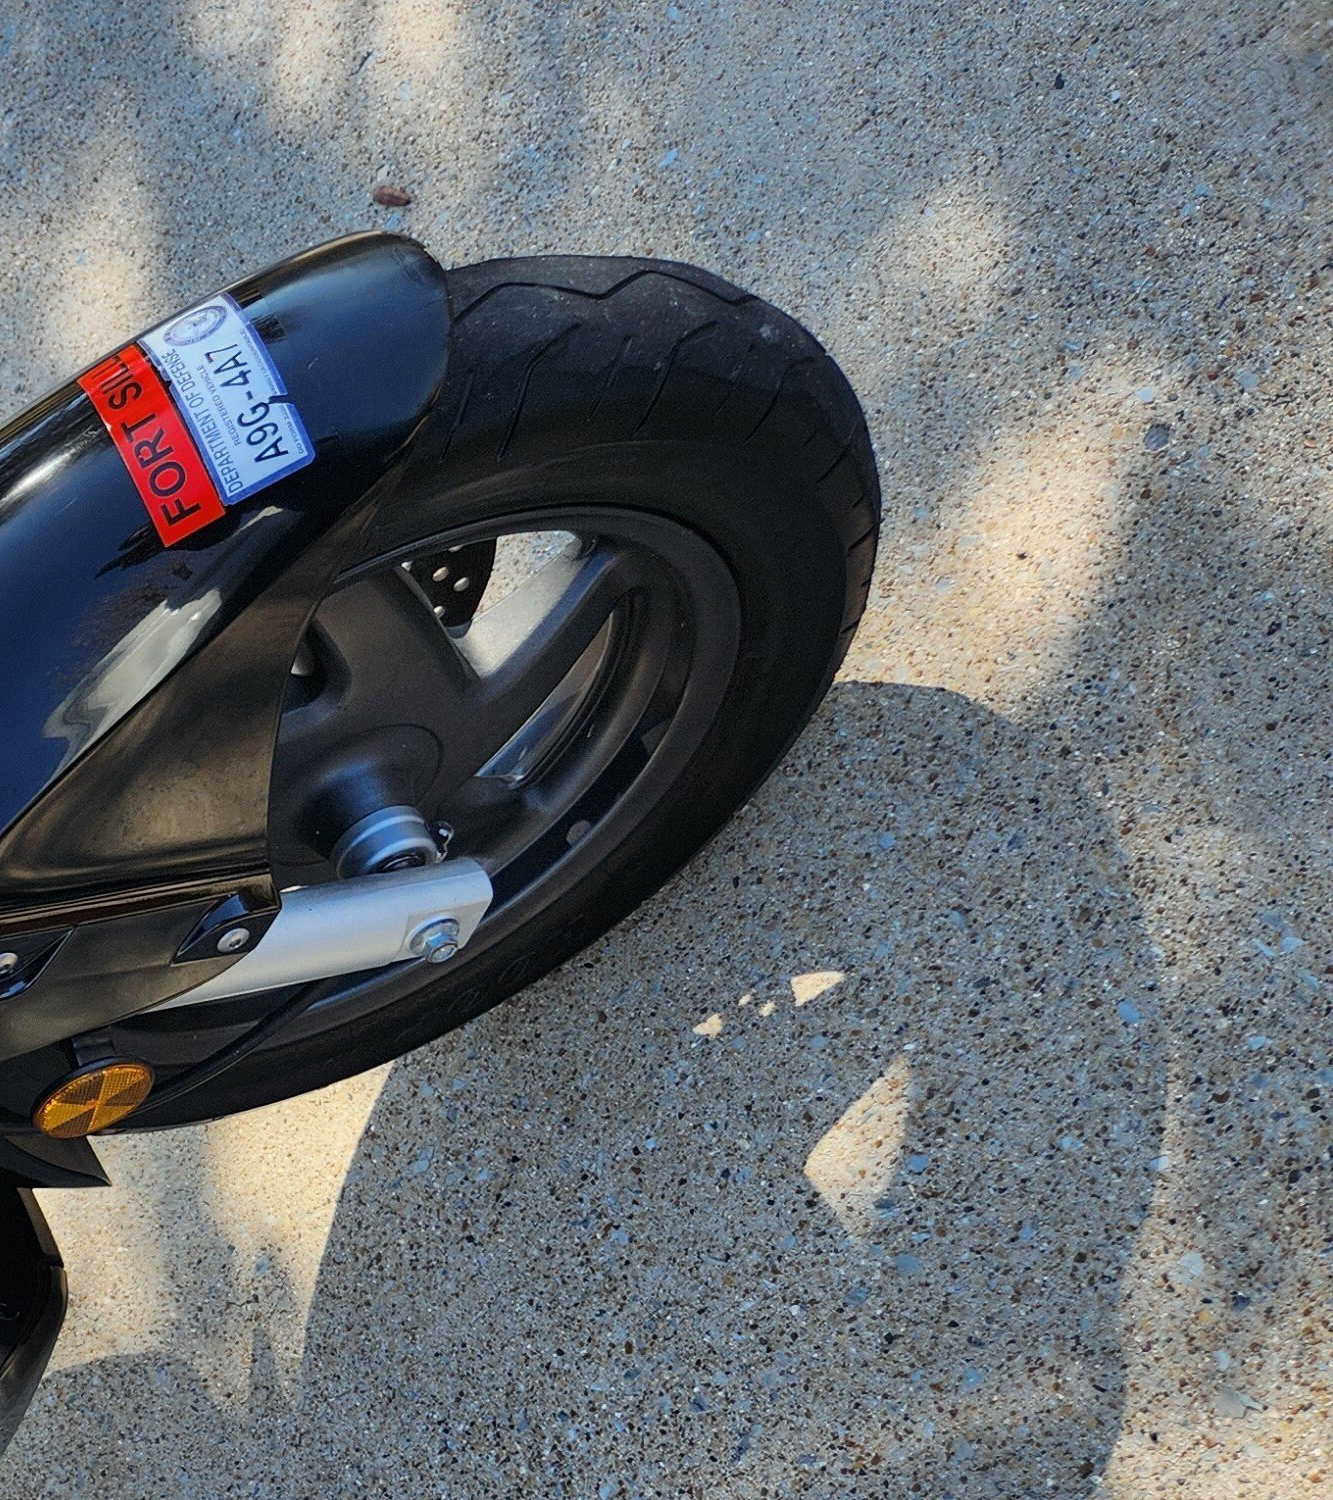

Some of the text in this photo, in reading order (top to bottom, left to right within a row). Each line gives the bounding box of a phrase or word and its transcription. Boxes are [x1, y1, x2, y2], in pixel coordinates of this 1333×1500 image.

[93, 356, 143, 410] SILL
[160, 349, 197, 389] DEFENSE
[181, 389, 205, 407] OF
[196, 364, 242, 446] REGISTERED VEHICLE
[203, 343, 290, 464] A9G-4A7
[192, 402, 244, 495] DEPARTMENT
[285, 421, 300, 443] FORM
[293, 442, 305, 455] DD
[121, 413, 201, 526] FORT
